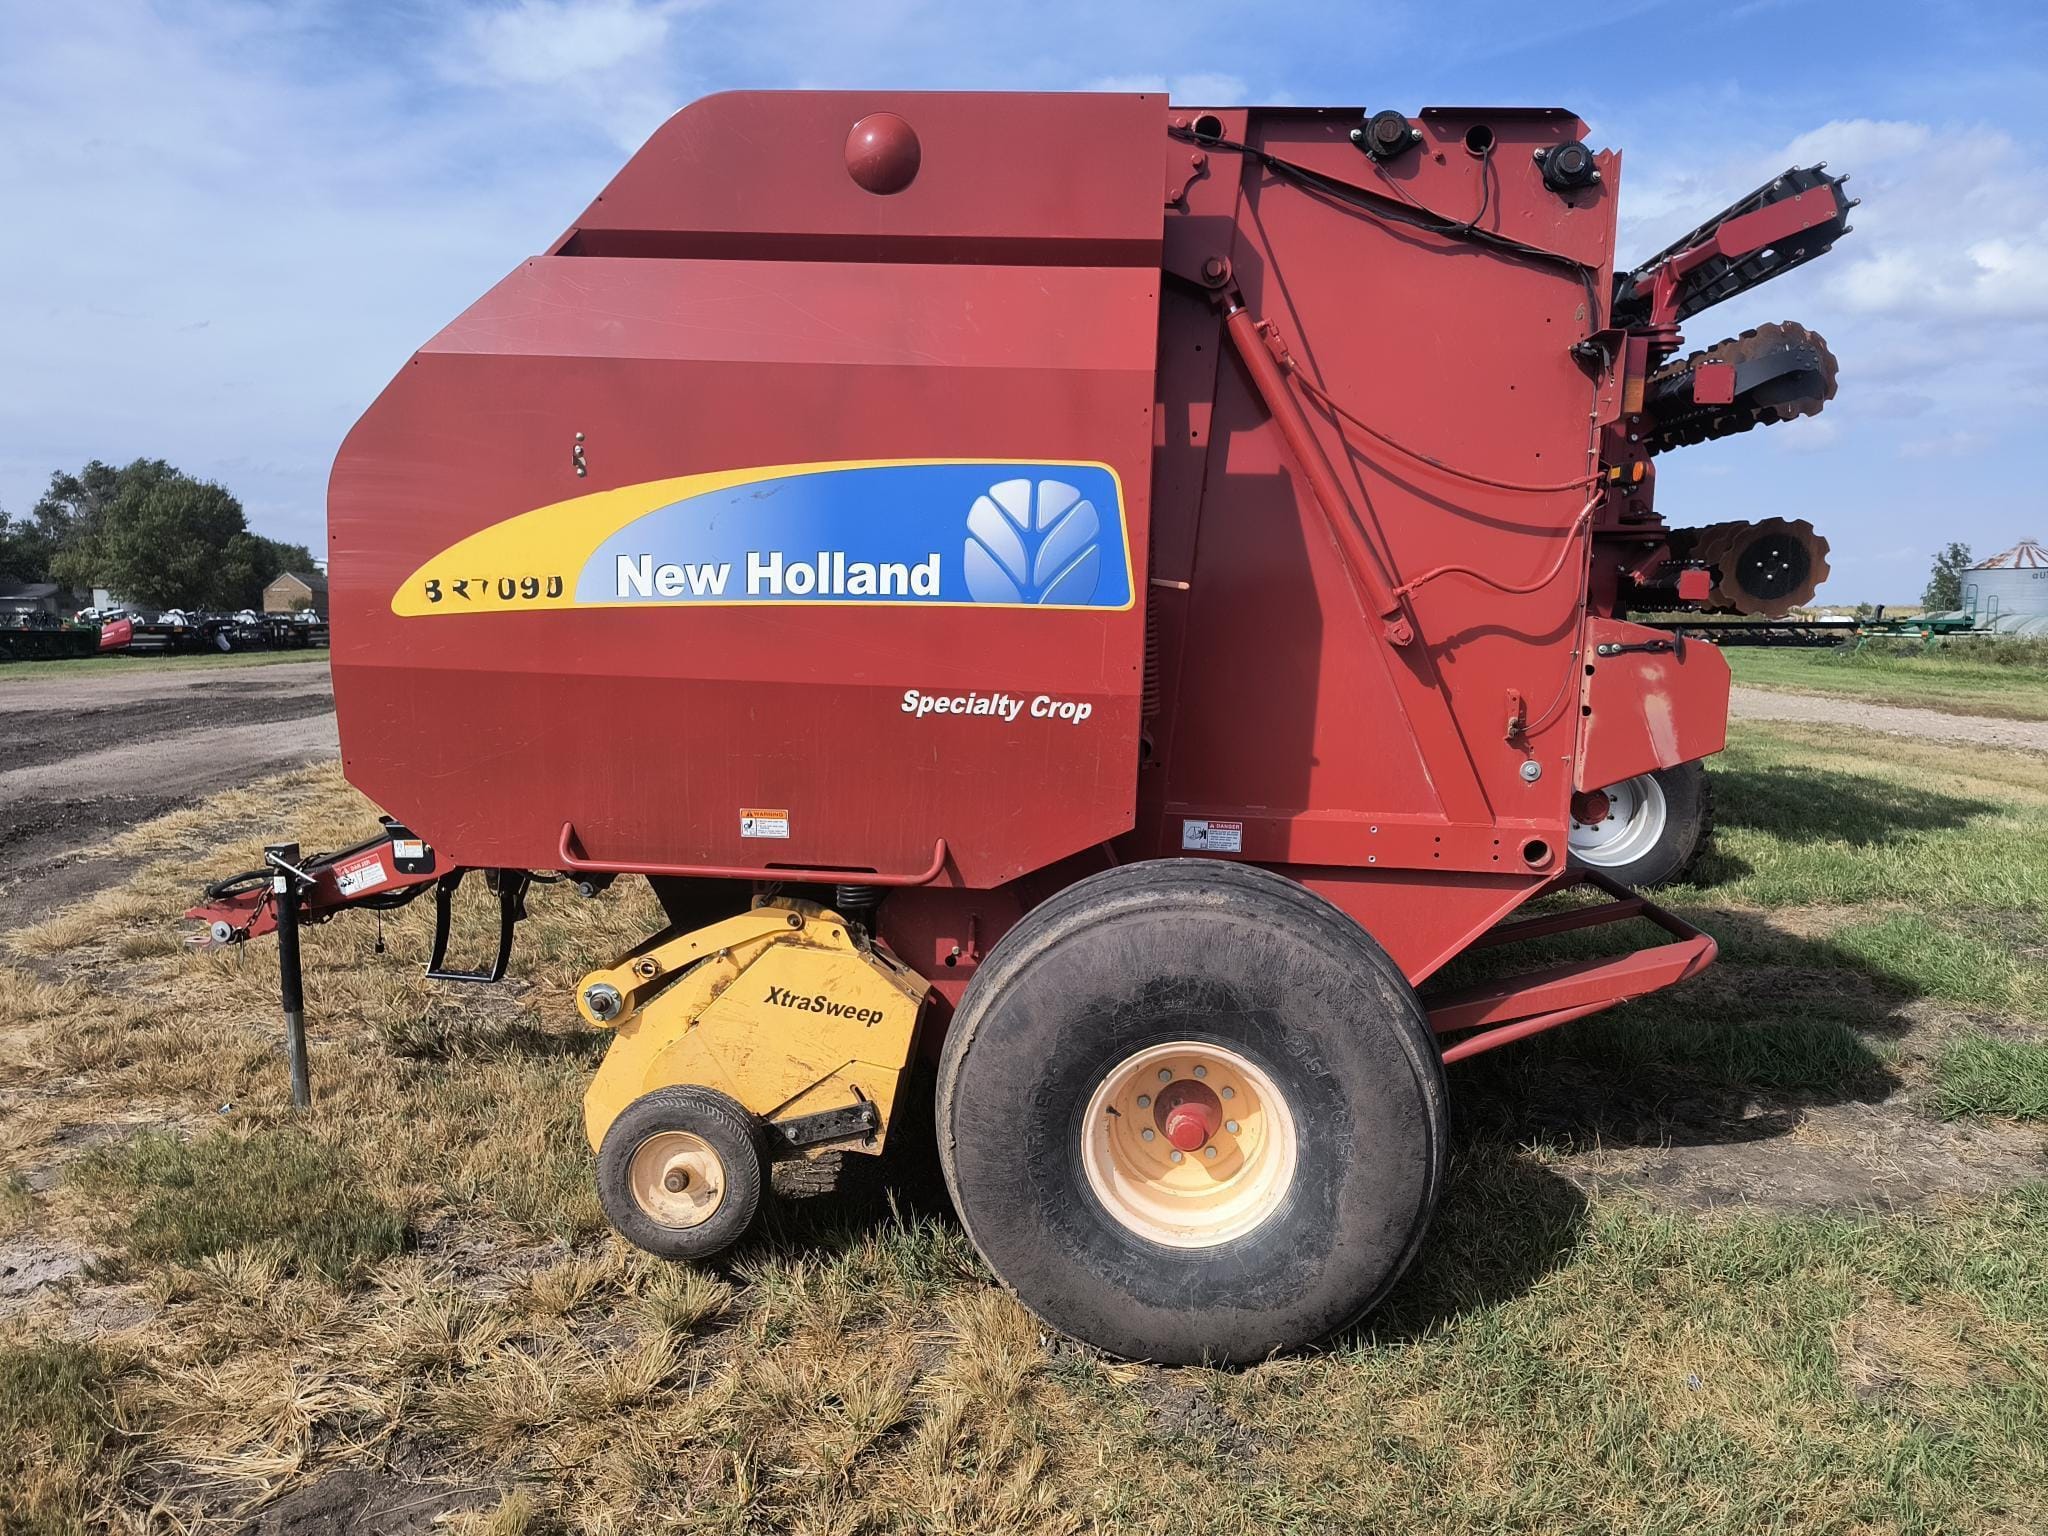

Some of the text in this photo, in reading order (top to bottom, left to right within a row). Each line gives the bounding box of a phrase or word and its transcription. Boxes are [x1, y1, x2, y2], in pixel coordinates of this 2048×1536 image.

[615, 551, 941, 598] New Holland
[901, 689, 1092, 725] Specialty Crop
[763, 986, 884, 1028] XtraSweep
